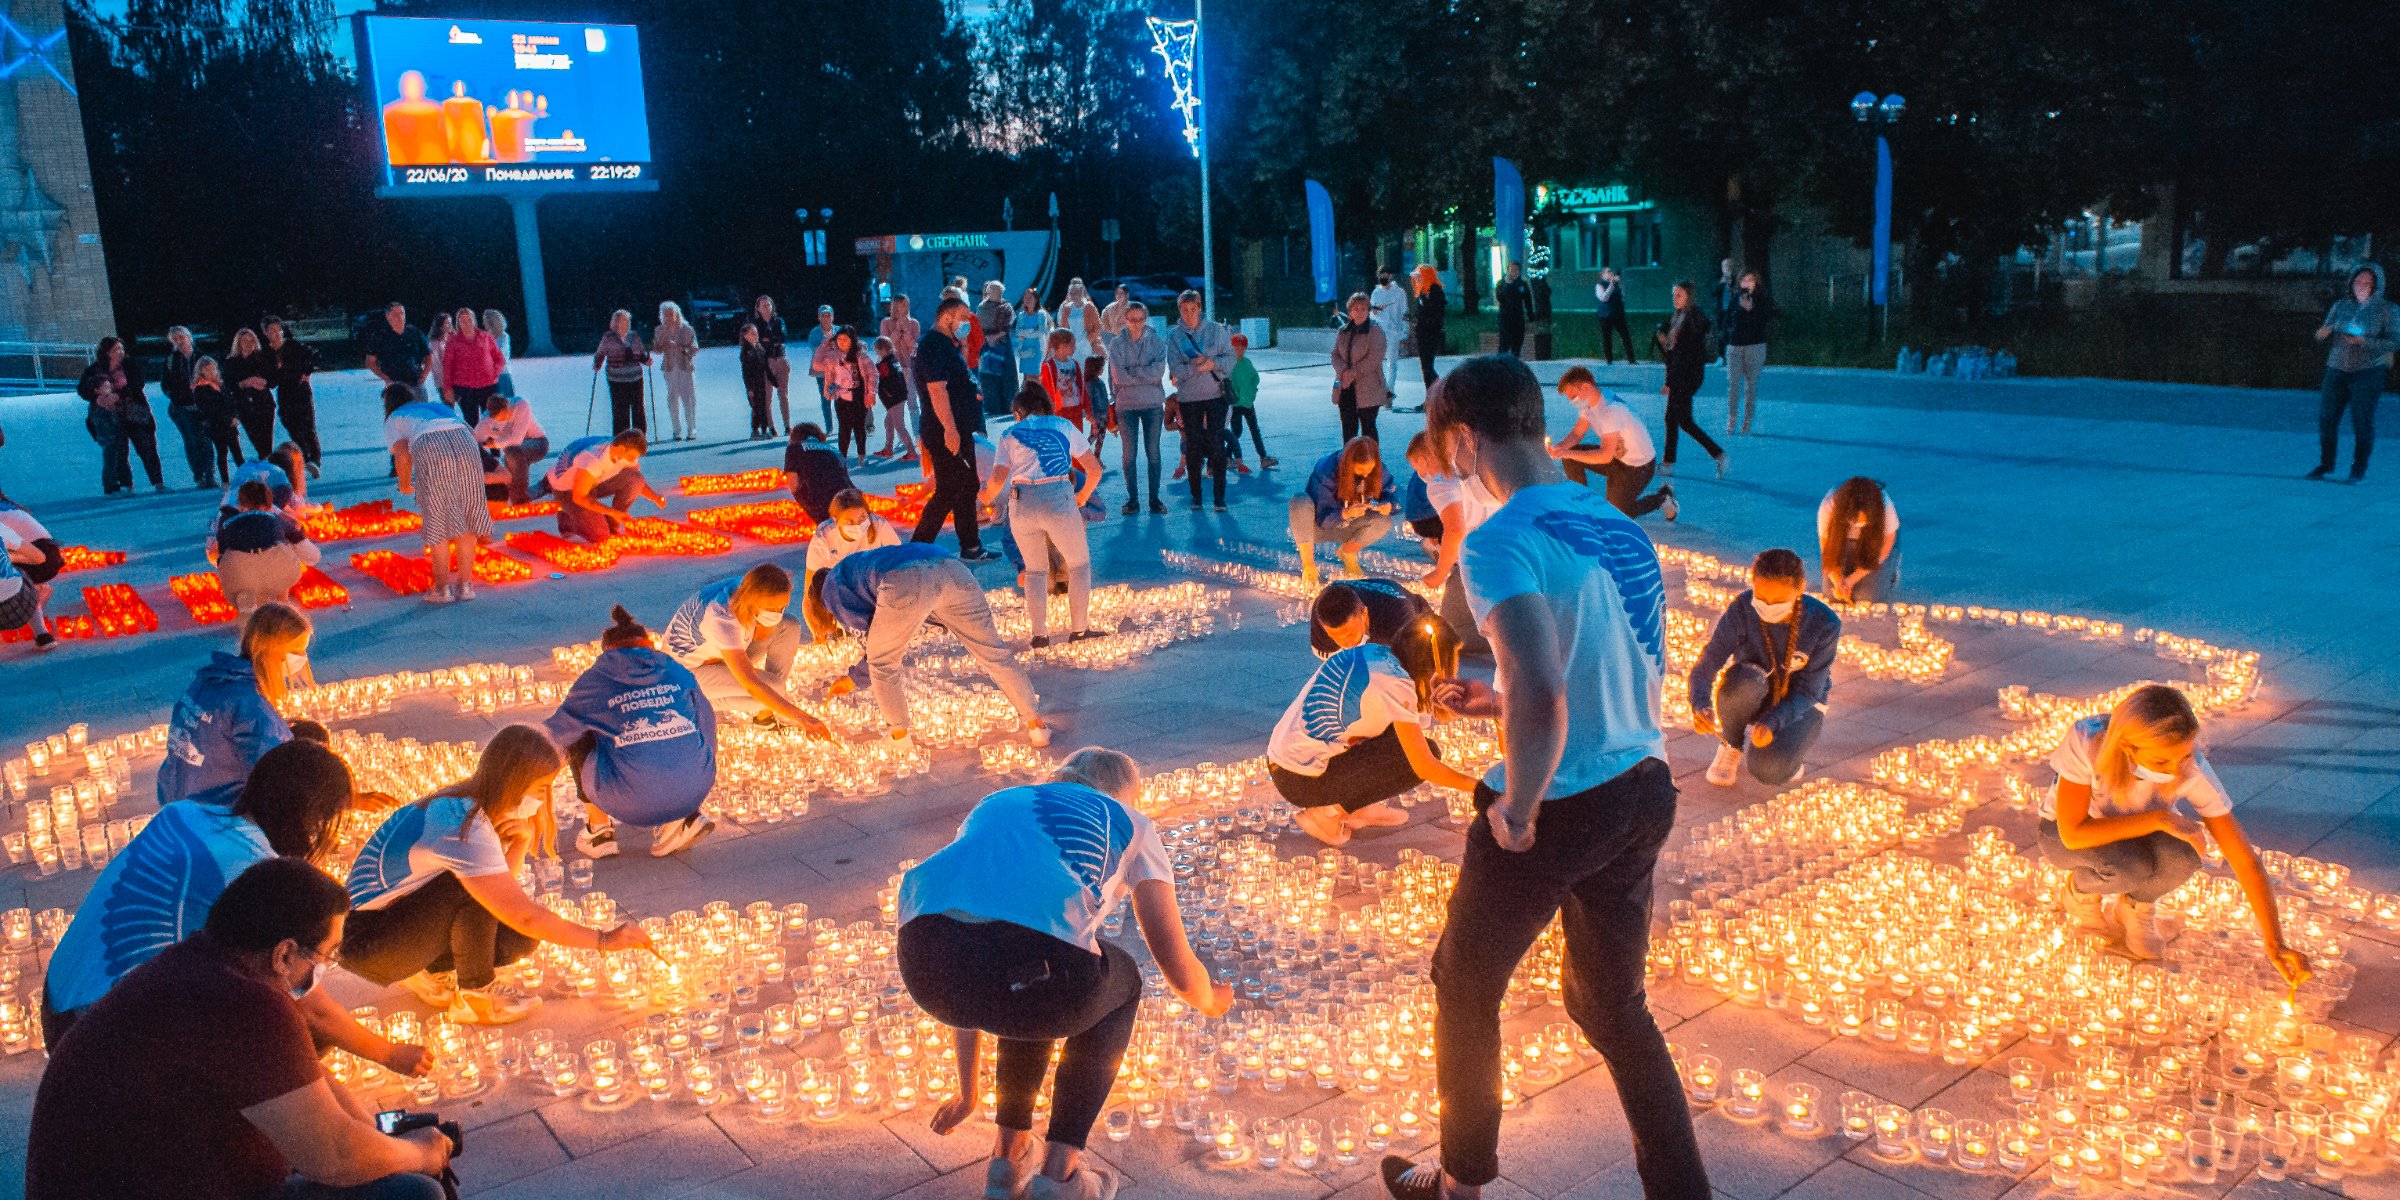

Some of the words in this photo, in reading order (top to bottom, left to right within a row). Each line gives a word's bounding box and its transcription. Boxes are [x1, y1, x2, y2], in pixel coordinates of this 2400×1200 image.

[406, 168, 468, 183] 22/06/20
[485, 167, 575, 182] Понедельник
[590, 166, 641, 179] 22:19:29
[927, 234, 988, 248] СБЕРБАНК
[608, 683, 681, 708] ВОЛОНТЁРЫ
[621, 695, 675, 713] ПОБЕДЫ
